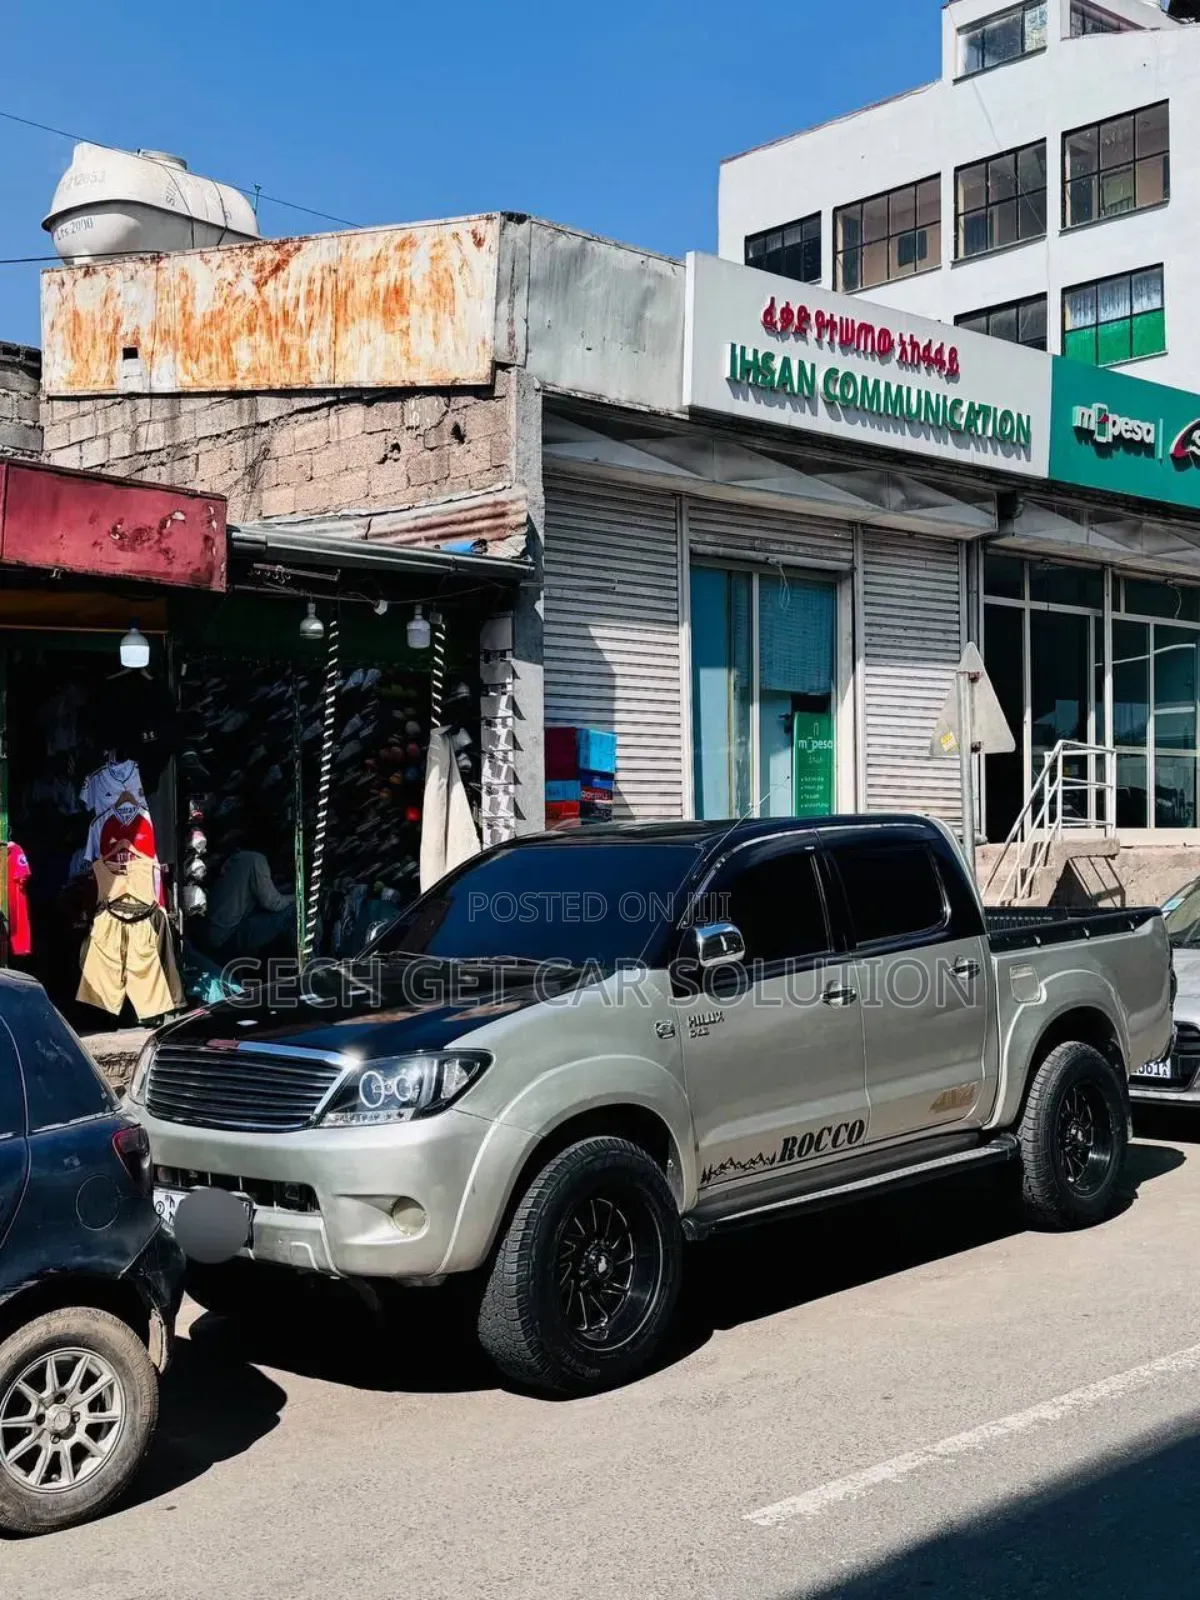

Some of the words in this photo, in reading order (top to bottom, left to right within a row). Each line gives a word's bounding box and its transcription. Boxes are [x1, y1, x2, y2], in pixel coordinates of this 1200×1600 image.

[70, 217, 93, 235] 2000
[727, 342, 816, 399] IHSAN
[822, 366, 1032, 449] COMMUNICATION
[776, 1118, 866, 1163] ROCCO
